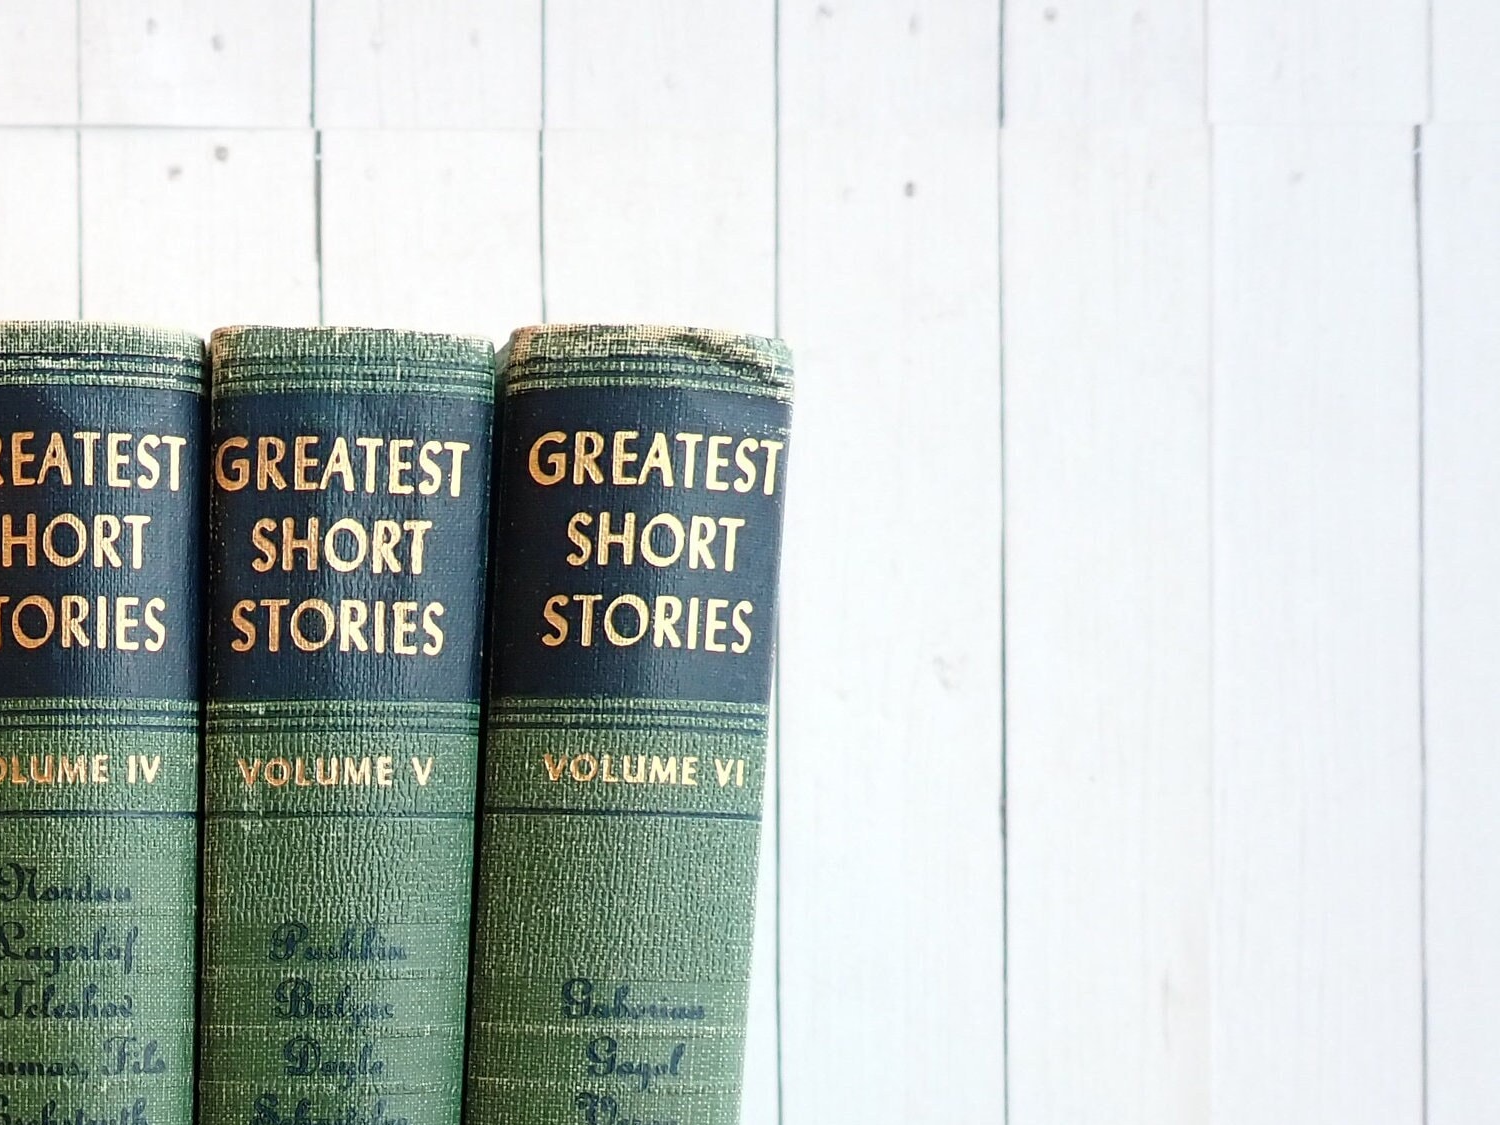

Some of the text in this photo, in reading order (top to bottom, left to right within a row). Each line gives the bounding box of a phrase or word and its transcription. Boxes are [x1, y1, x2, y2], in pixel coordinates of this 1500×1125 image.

[215, 435, 470, 497] GREATEST
[528, 430, 784, 496] GREATEST
[251, 516, 432, 575] SHORT
[566, 511, 746, 571] SHORT
[230, 598, 444, 656] STORIES
[541, 593, 754, 653] STORIES
[127, 755, 161, 784] IV
[236, 756, 434, 789] VOLUME V
[542, 751, 745, 787] VOLUME VI
